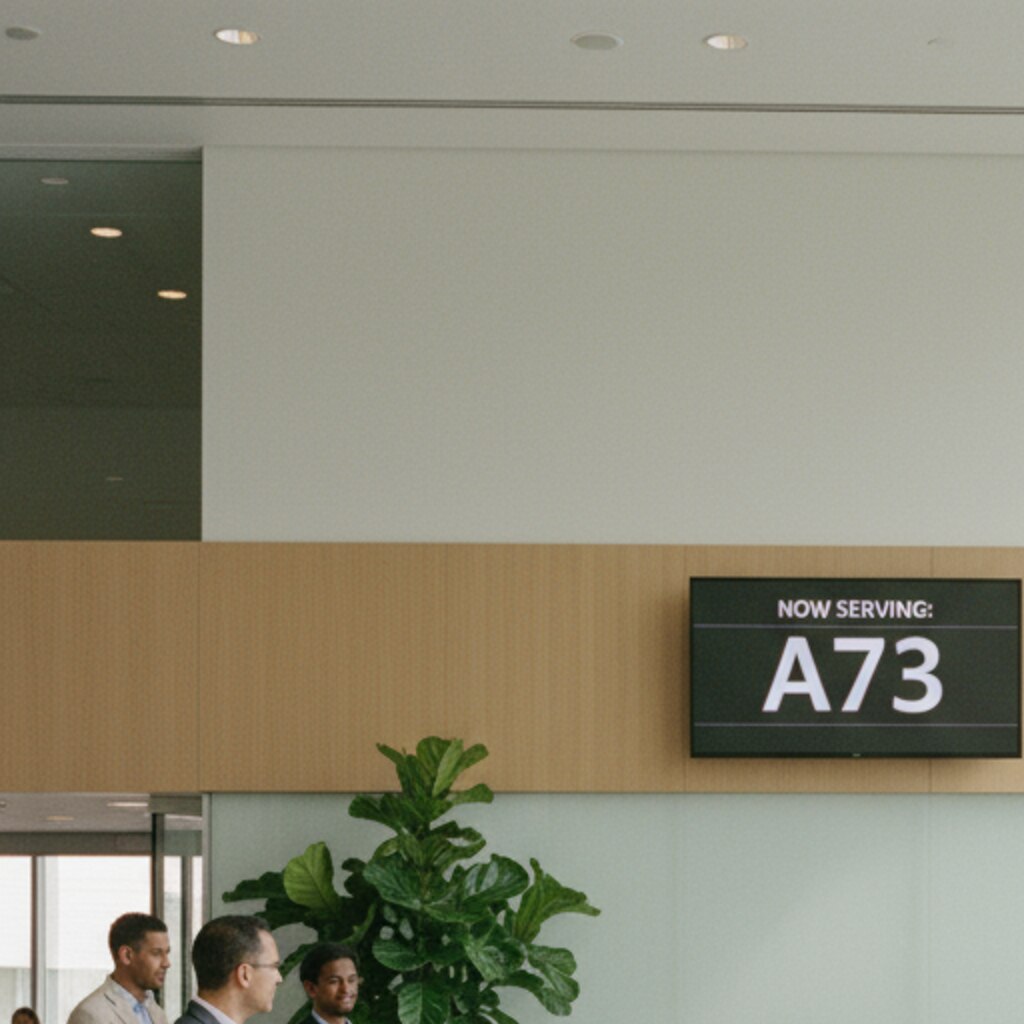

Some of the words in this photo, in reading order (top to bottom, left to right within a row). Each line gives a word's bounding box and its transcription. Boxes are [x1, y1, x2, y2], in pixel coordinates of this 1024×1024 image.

[777, 599, 831, 619] NOW
[836, 599, 933, 619] SERVING:
[761, 635, 944, 714] A73
